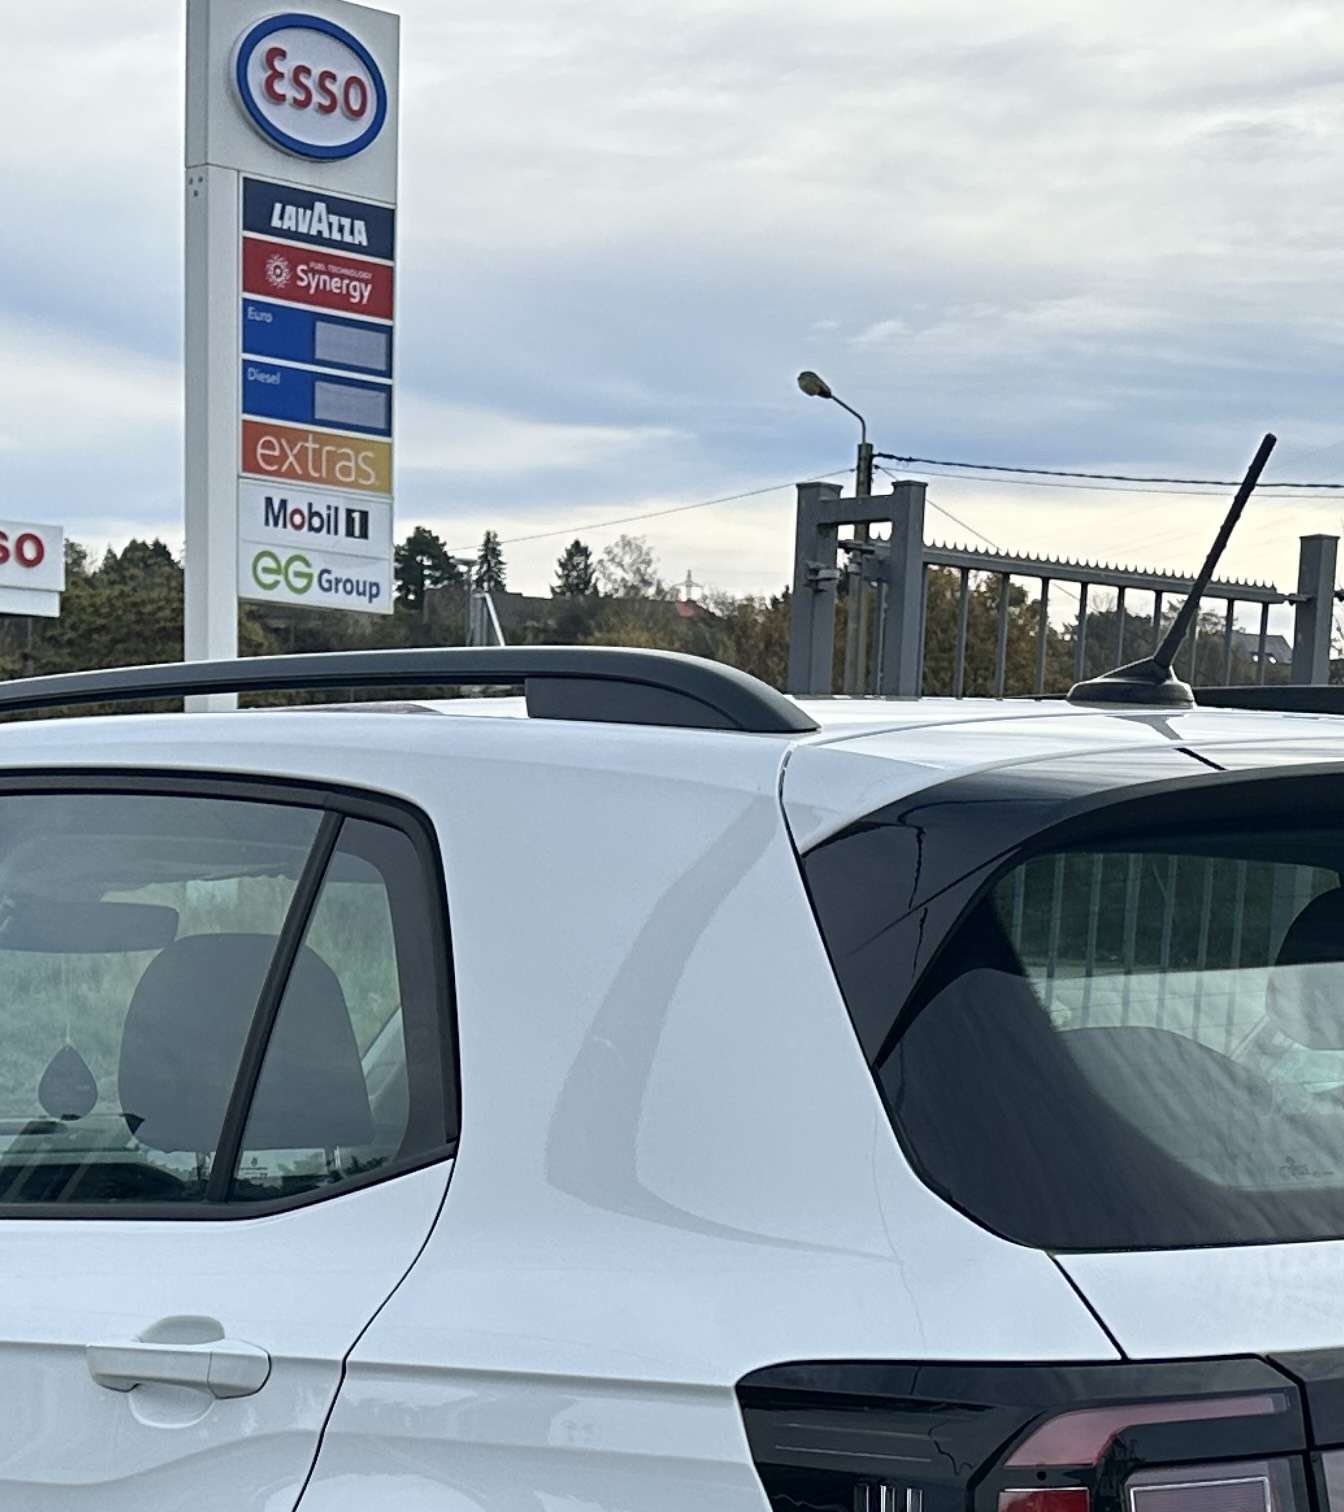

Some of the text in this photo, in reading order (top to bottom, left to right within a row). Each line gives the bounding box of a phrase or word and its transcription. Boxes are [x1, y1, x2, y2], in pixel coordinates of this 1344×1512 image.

[270, 201, 368, 246] LAVAZZA
[296, 264, 373, 304] Synergy
[247, 305, 273, 324] Euro
[247, 366, 281, 385] Diesel
[255, 433, 377, 485] extras
[264, 496, 339, 536] Mobil
[317, 568, 381, 604] Group
